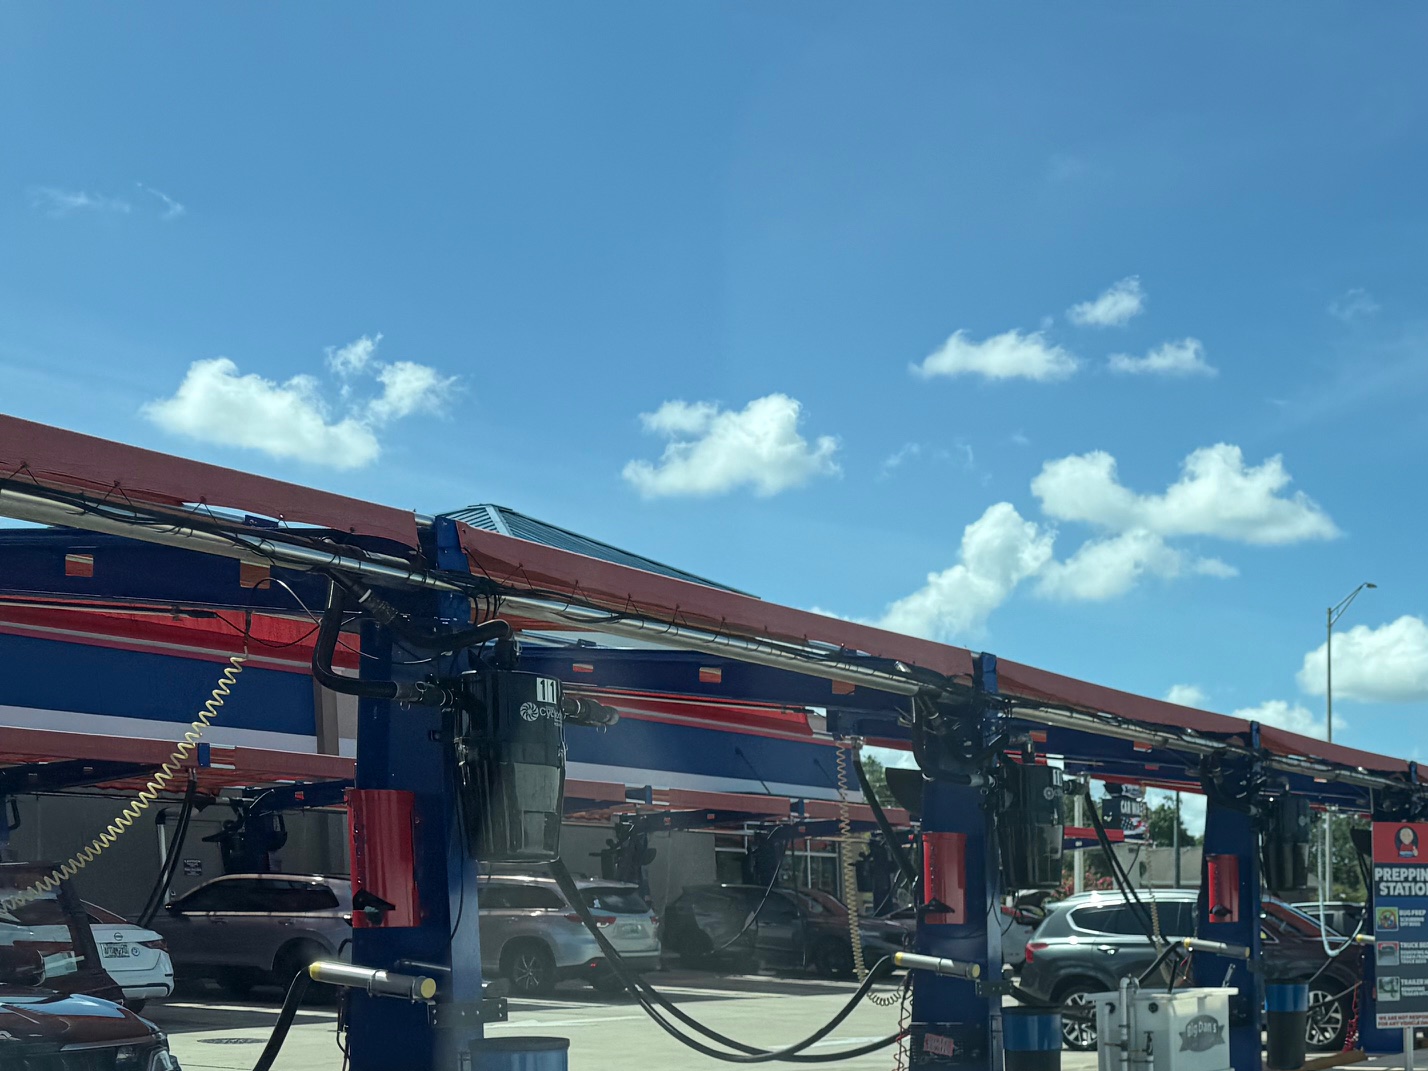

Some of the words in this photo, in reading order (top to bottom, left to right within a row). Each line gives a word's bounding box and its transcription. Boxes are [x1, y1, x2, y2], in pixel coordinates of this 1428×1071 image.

[540, 679, 555, 702] 11
[1187, 1022, 1198, 1038] Big
[1198, 1020, 1217, 1033] Dan's
